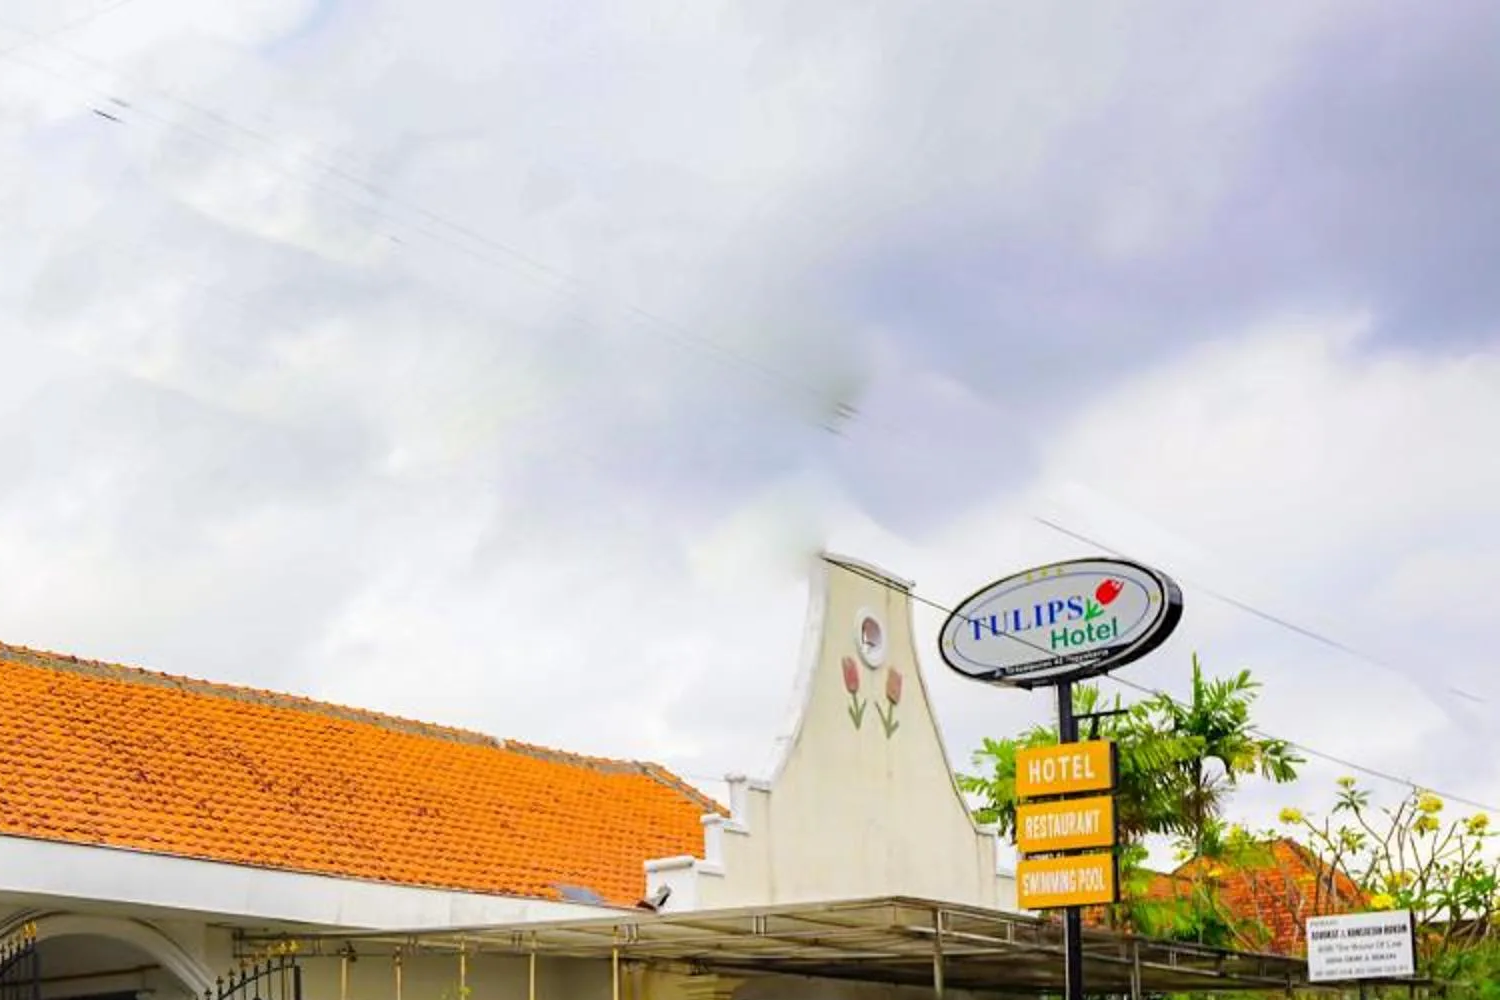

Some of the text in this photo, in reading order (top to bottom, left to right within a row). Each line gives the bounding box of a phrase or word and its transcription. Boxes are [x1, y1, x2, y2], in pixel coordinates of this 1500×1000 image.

[967, 595, 1084, 641] TULIPS
[1050, 615, 1119, 650] Hotel
[1028, 754, 1096, 785] HOTEL
[1025, 809, 1101, 840] RESTAURANT
[1078, 866, 1106, 892] POOL
